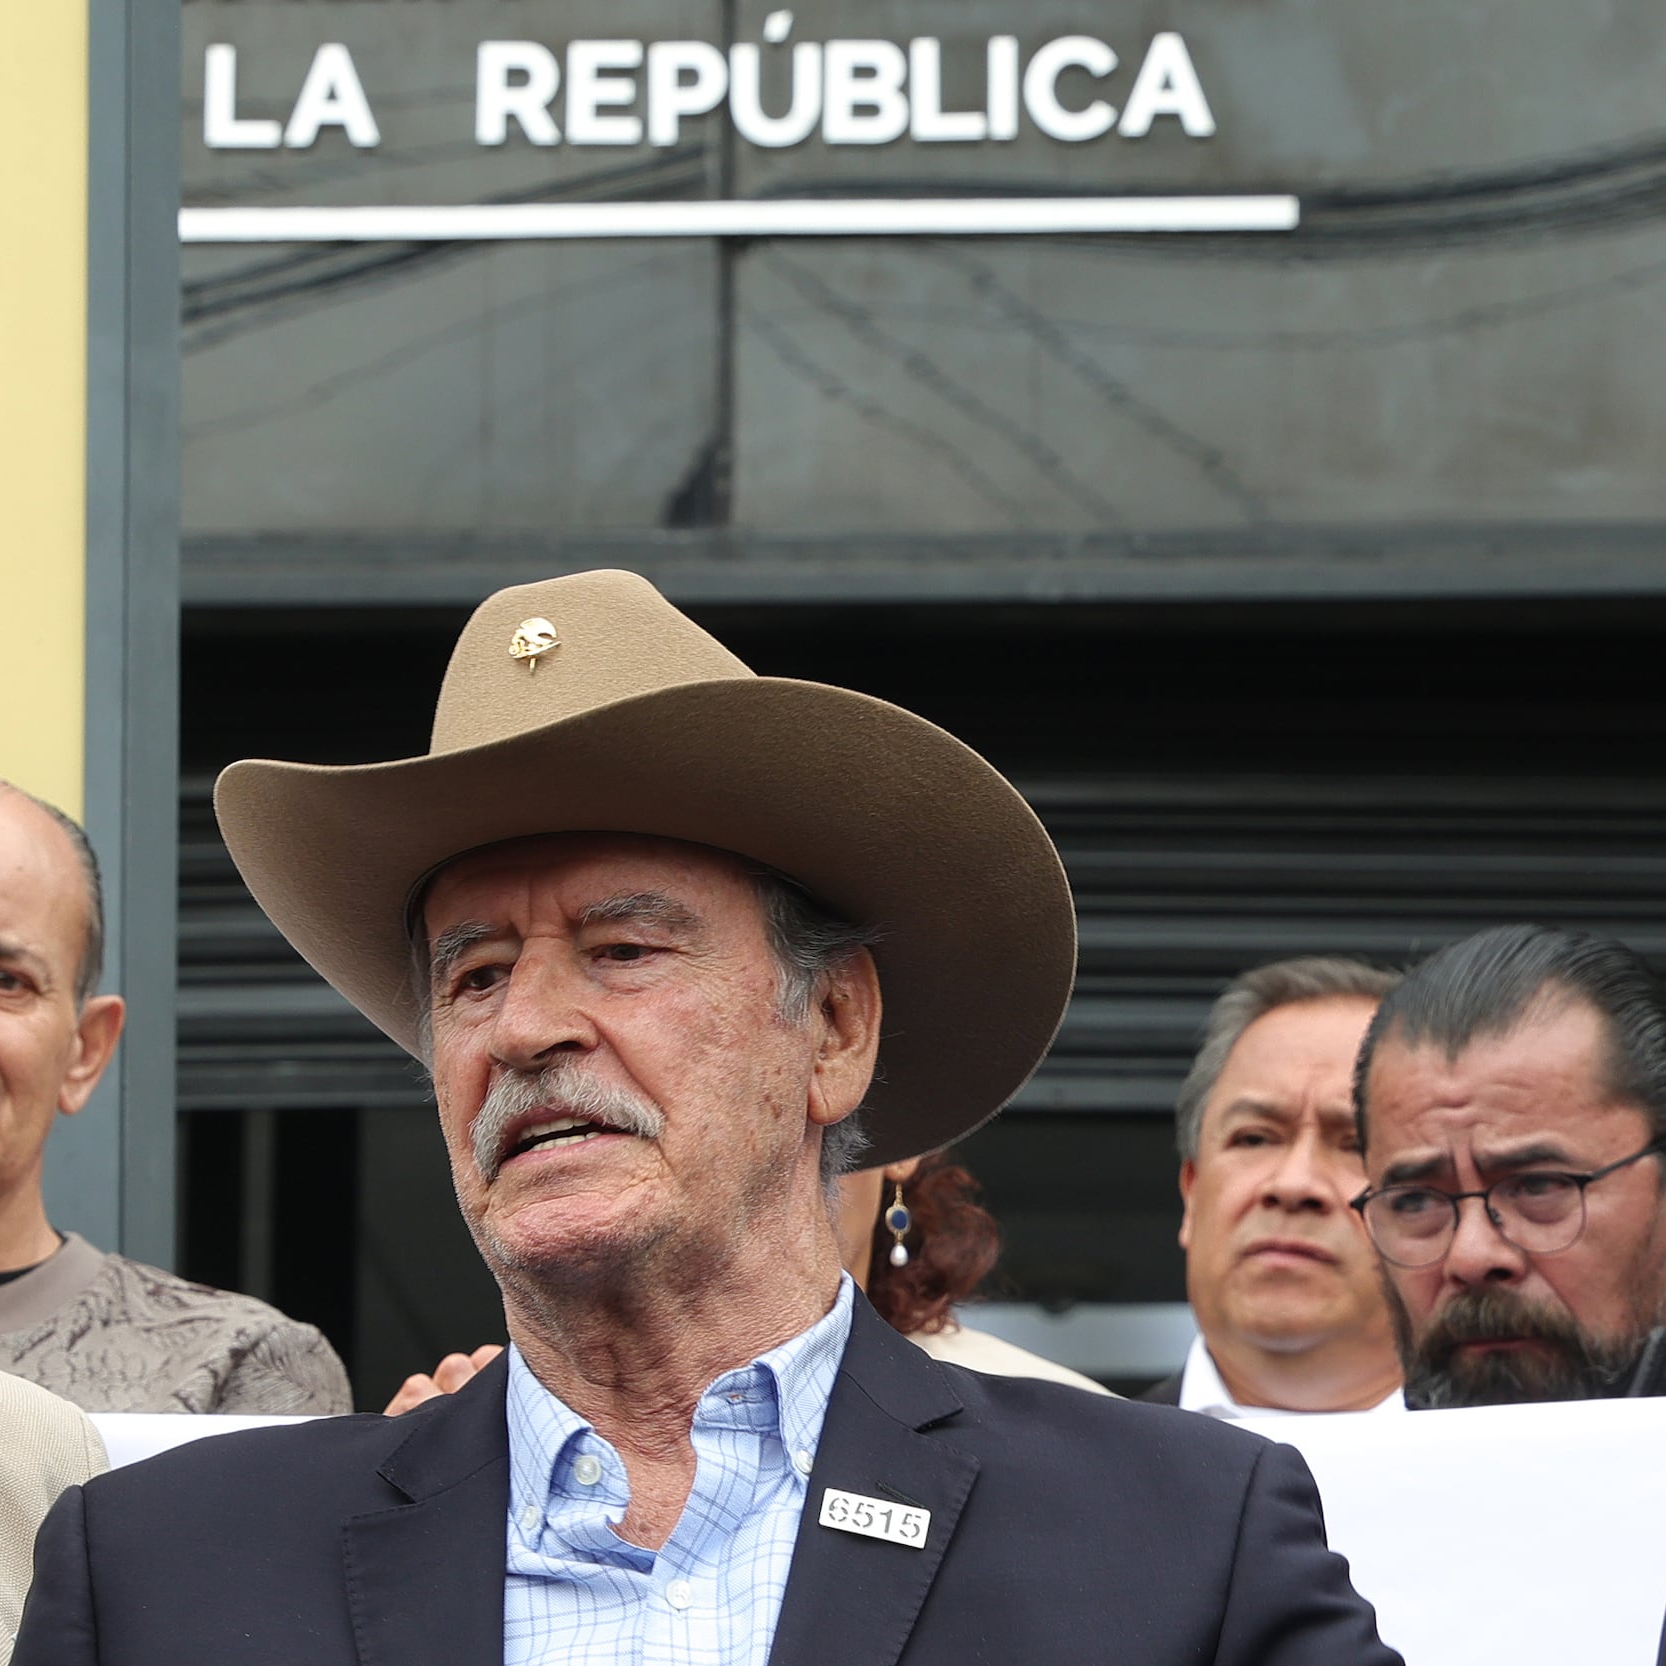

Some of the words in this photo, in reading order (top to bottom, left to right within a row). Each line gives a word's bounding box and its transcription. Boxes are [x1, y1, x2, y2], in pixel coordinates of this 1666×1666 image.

[203, 41, 380, 148] LA
[475, 9, 1215, 147] REPÚBLICA
[828, 1497, 922, 1539] 6515
